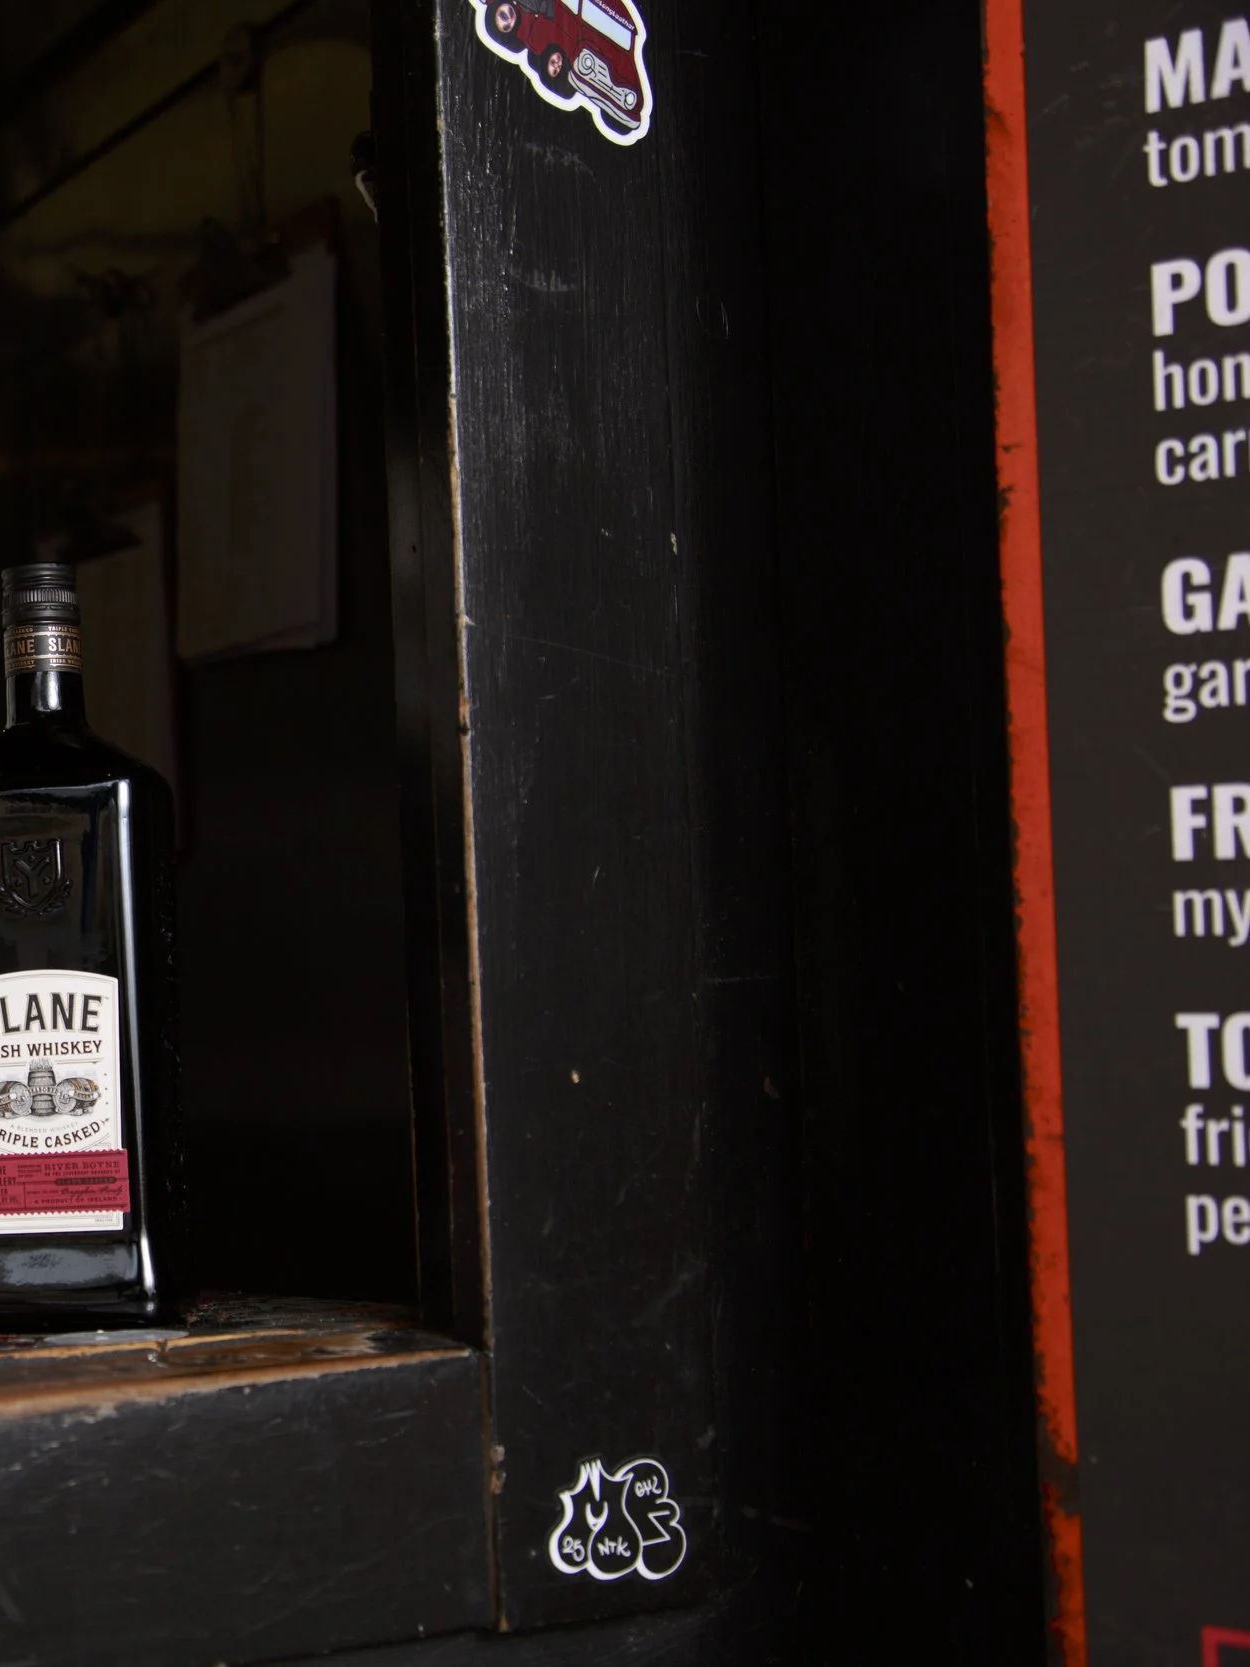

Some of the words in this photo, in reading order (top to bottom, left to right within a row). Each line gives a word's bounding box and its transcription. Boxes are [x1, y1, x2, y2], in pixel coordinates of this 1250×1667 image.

[1144, 18, 1250, 114] MA
[1143, 122, 1250, 187] tom
[1151, 248, 1250, 337] PO
[1154, 427, 1250, 486] car
[1161, 552, 1250, 635] GA
[1162, 658, 1250, 723] gar
[1170, 783, 1250, 862] FR
[1173, 888, 1250, 948] my
[27, 1040, 102, 1057] WHISKEY
[44, 1121, 101, 1148] CASKED
[44, 1162, 79, 1171] RIVER
[83, 1161, 120, 1169] BOYNE
[1185, 1194, 1250, 1255] pe
